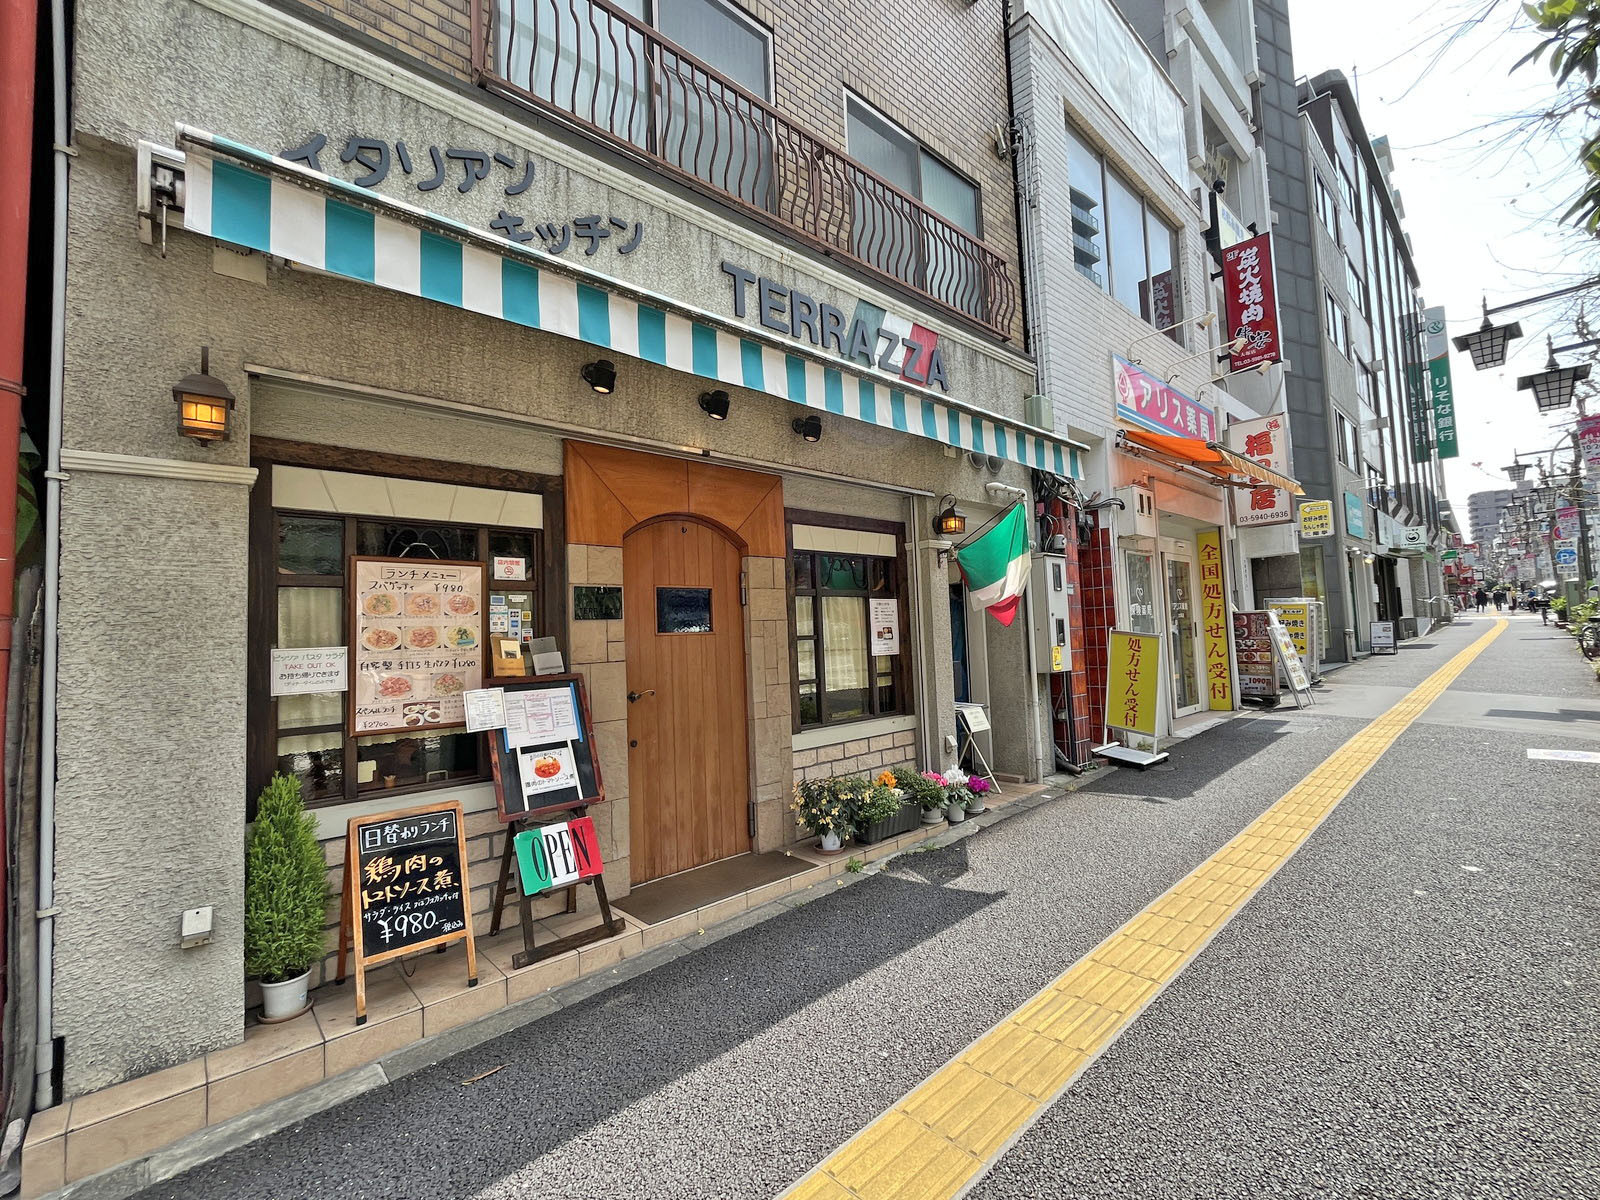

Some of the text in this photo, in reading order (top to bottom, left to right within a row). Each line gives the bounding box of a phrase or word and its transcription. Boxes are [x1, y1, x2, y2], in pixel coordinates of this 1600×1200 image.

[280, 133, 535, 195] イタリアン
[490, 210, 643, 256] キッチン
[1236, 246, 1264, 325] 炭火焼肉
[721, 261, 949, 392] TERRAZZA
[1434, 375, 1454, 442] りそな銀行
[1240, 511, 1289, 523] 03-5940-6936
[1200, 543, 1230, 700] 全国処方せん受付
[1124, 636, 1142, 728] 処方せん受付
[365, 817, 450, 848] 日替わりランチ
[531, 826, 592, 882] OPEN
[362, 869, 459, 909] トマトソース煮
[364, 854, 444, 886] 鶏肉の
